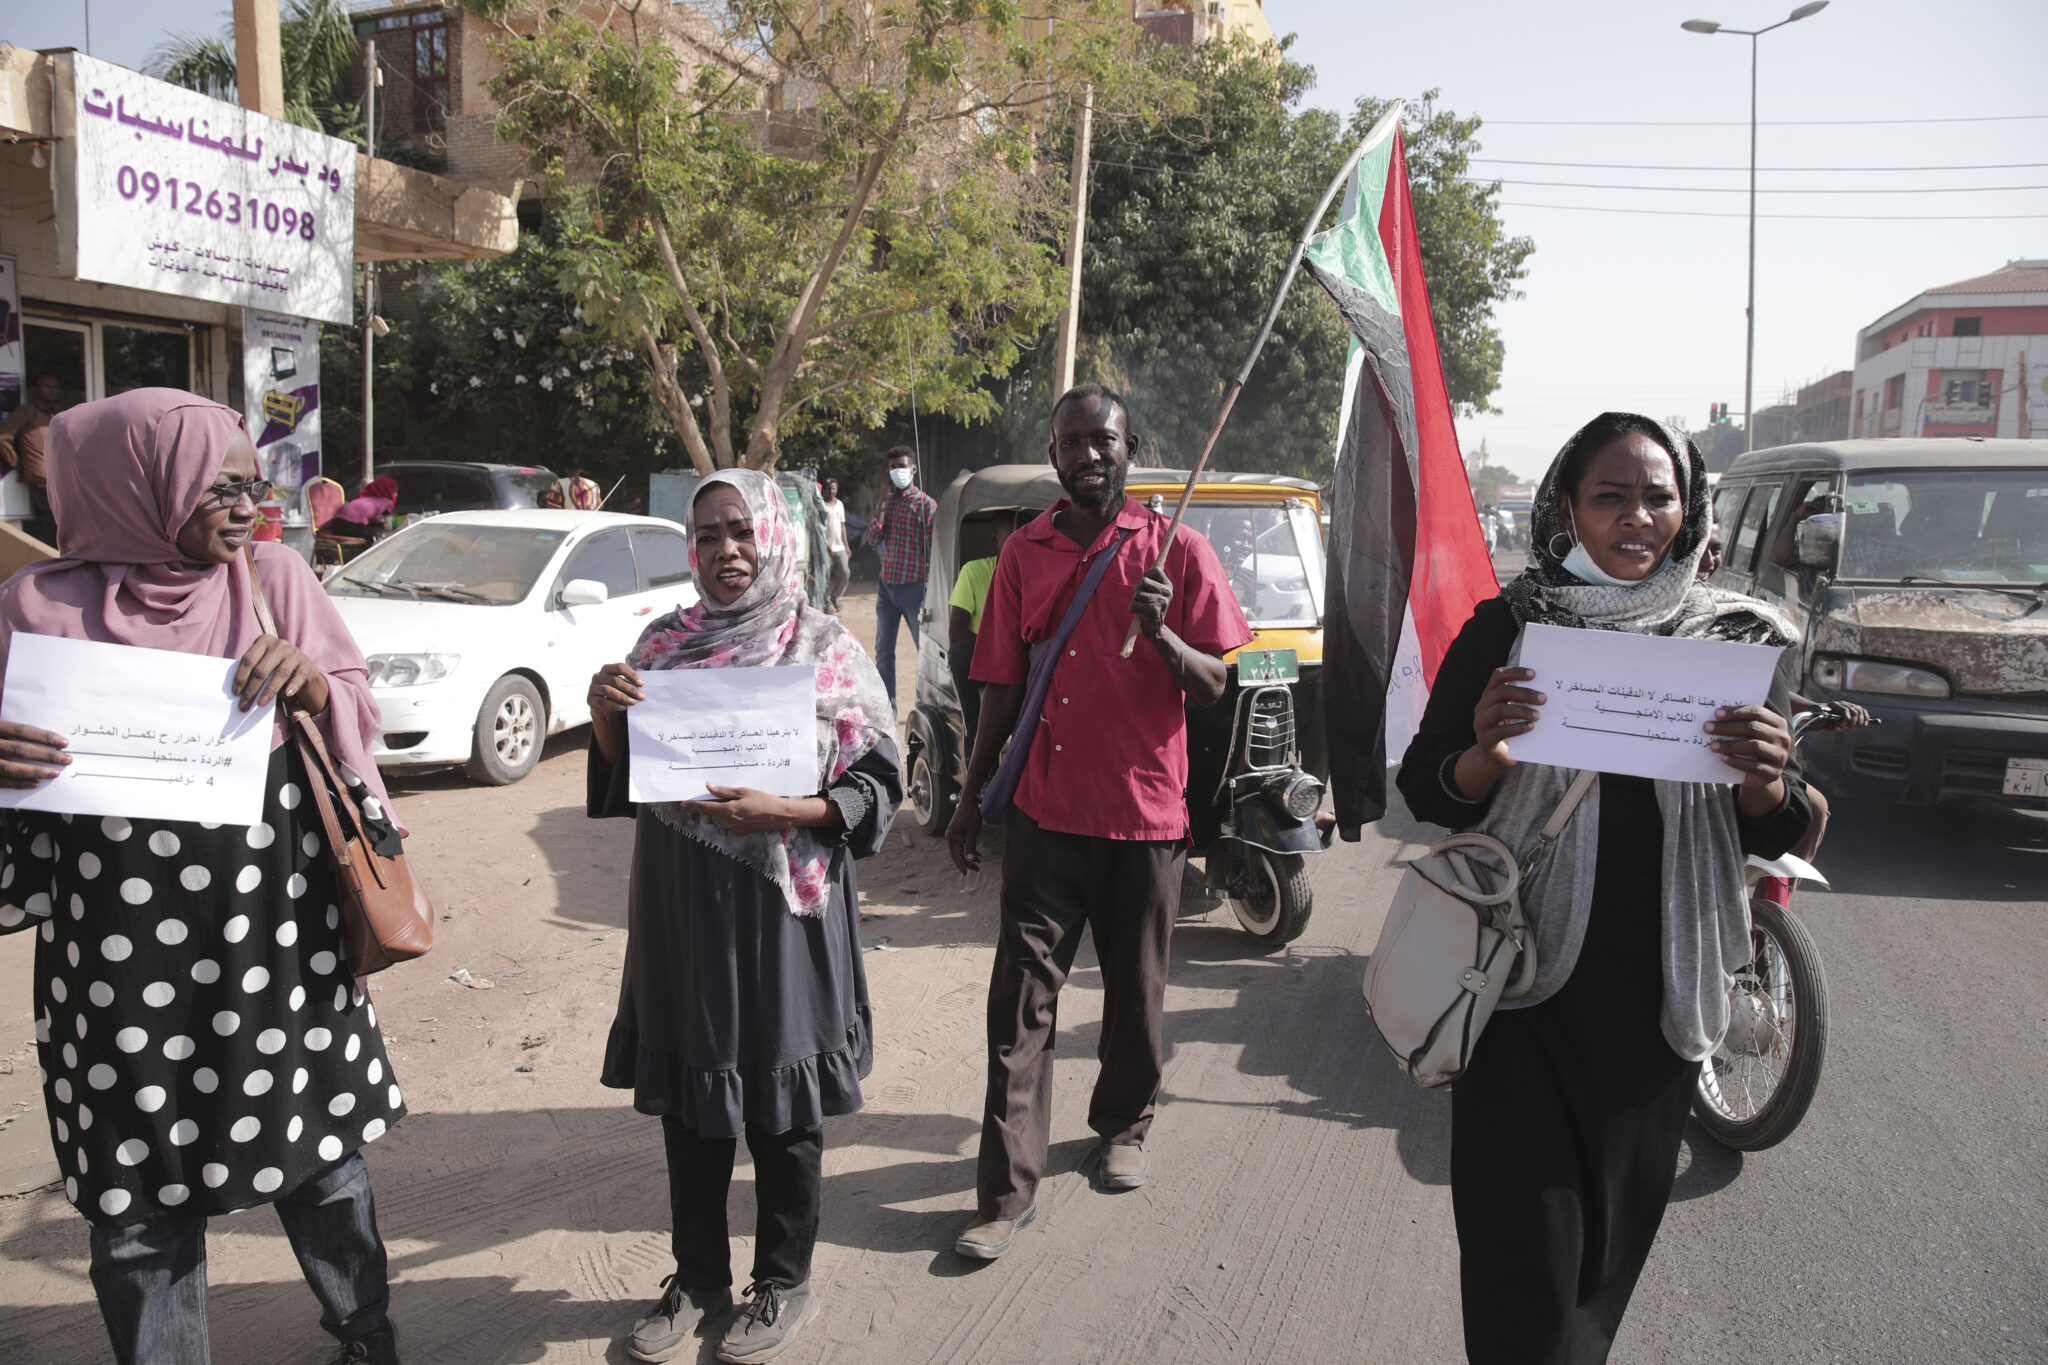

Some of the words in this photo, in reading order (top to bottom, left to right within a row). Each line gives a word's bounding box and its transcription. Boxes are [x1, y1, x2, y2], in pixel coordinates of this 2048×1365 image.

[83, 88, 263, 162] للمناسبات
[268, 153, 309, 185] بدر
[317, 162, 341, 193] ود
[117, 165, 315, 241] 0912631098
[1555, 680, 1563, 689] لا
[1567, 682, 1604, 694] المساخر
[1607, 686, 1644, 699] الدقينات
[1648, 690, 1655, 700] لا
[1658, 692, 1694, 704] العساكر
[1667, 712, 1696, 723] الكلاب
[658, 733, 664, 741] لا
[667, 731, 697, 742] المساخر
[728, 730, 735, 738] لا
[738, 729, 763, 739] العساكر
[793, 728, 799, 736] لا
[174, 733, 201, 744] احرار
[204, 734, 226, 747] ثوار
[745, 742, 768, 753] الكلاب
[206, 776, 214, 786] 4
